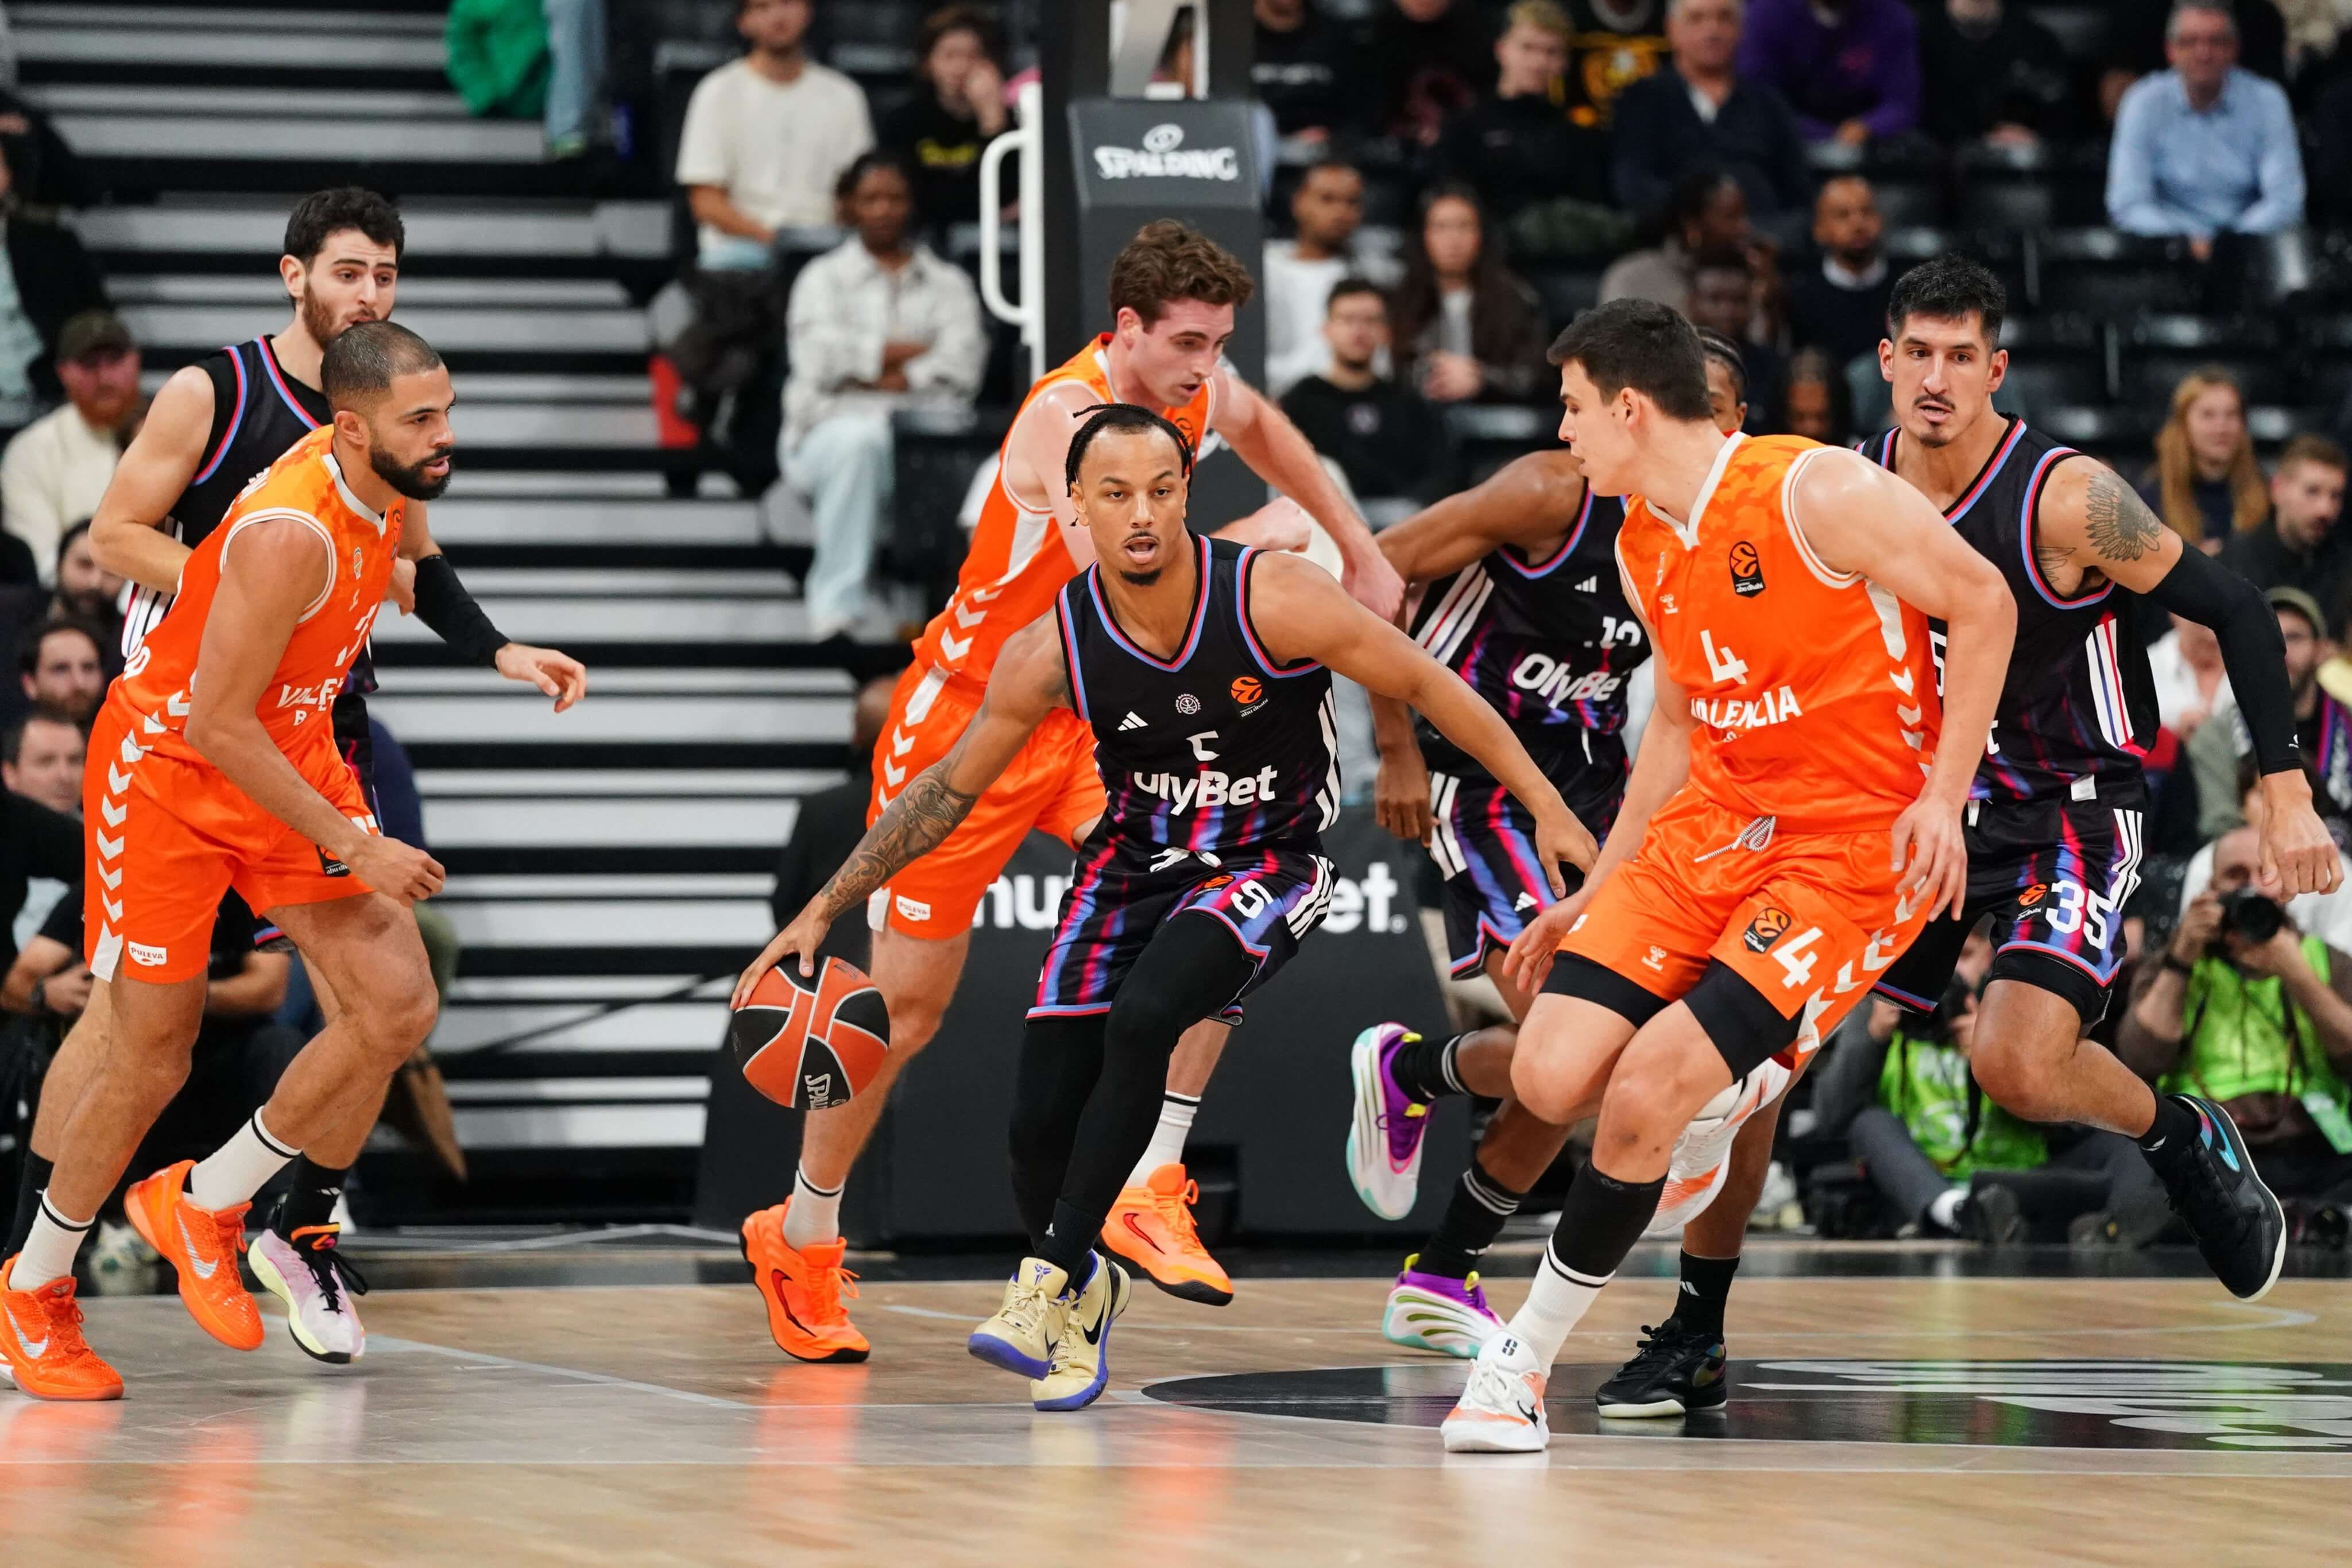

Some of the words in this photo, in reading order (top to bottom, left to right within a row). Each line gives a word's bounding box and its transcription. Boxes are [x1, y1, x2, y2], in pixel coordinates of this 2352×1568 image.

[1094, 146, 1239, 181] SPALDING
[1512, 653, 1622, 710] OlyBe
[1700, 629, 1749, 684] 4
[1231, 880, 1274, 919] 5
[2045, 880, 2117, 950] 35
[130, 947, 164, 959] PULEVA
[1771, 926, 1824, 989] 4
